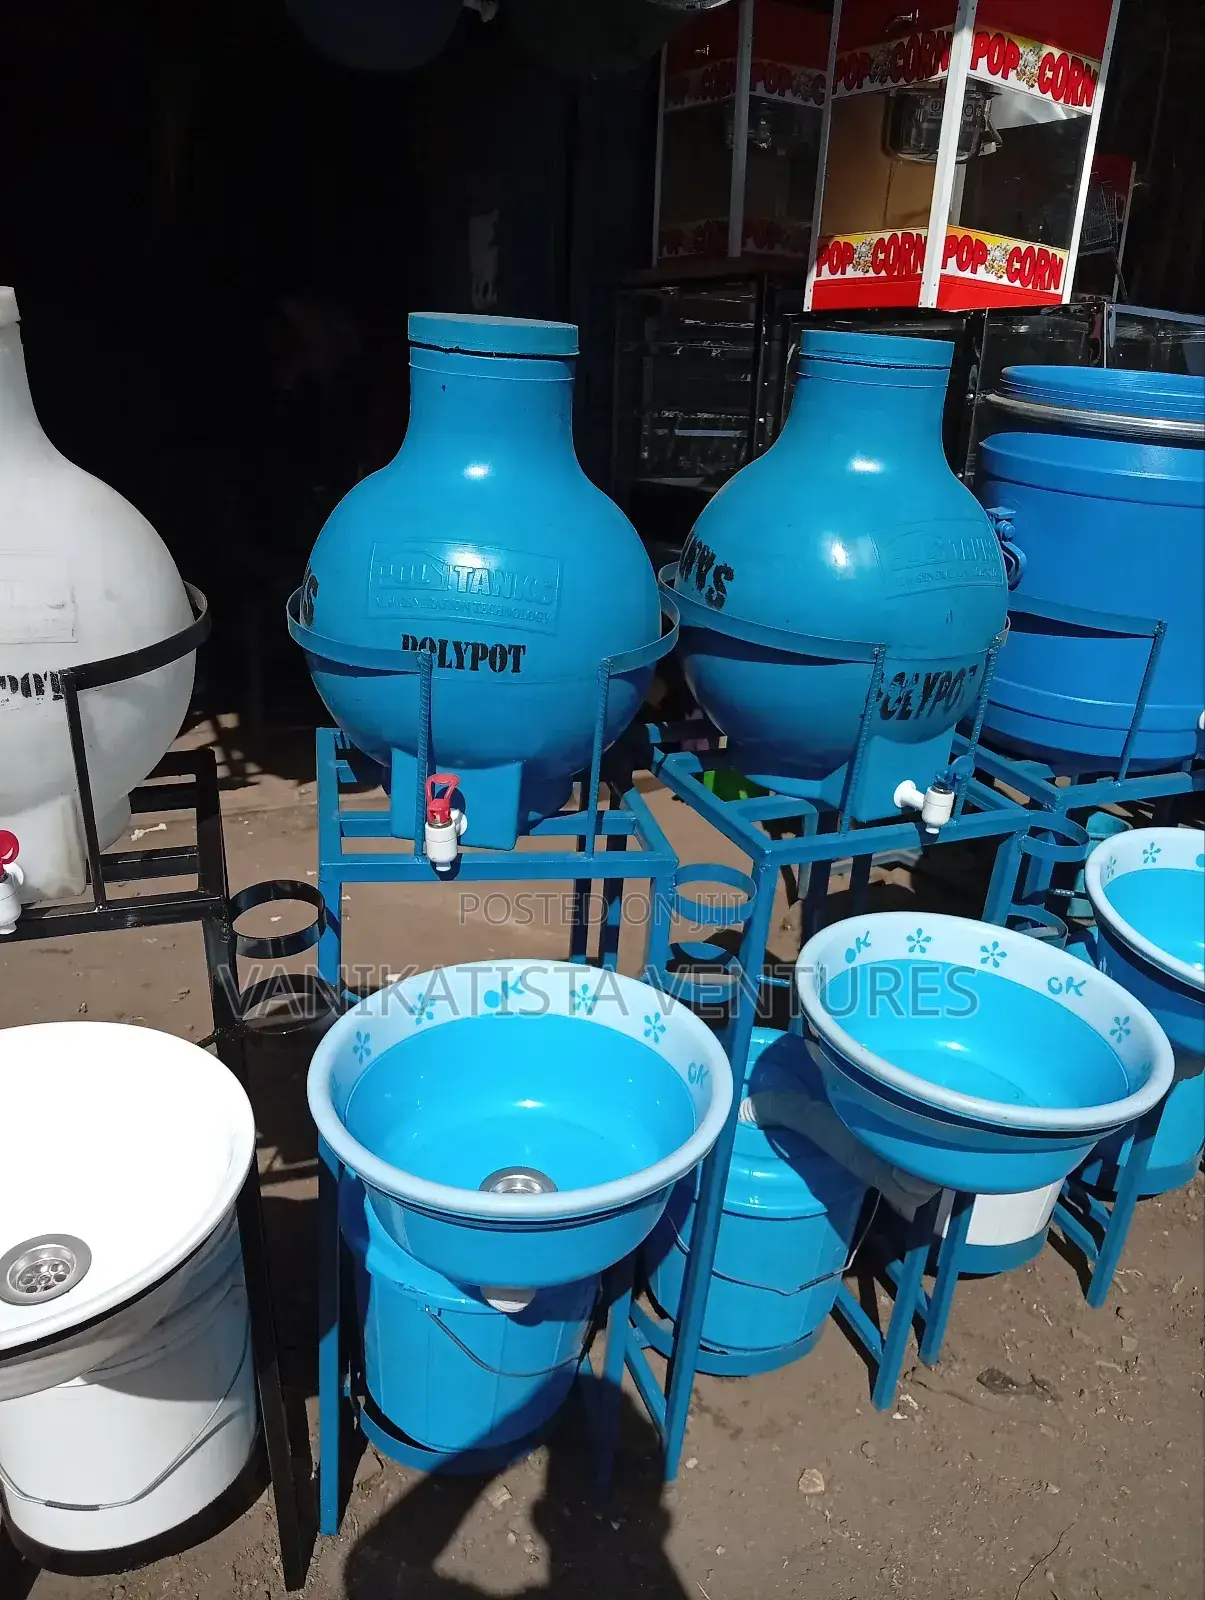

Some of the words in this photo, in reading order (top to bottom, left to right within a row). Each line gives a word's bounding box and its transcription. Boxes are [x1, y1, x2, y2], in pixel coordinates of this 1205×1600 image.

[890, 30, 954, 84] CORN
[970, 32, 1020, 80] POP
[1038, 52, 1099, 107] CORN
[816, 241, 854, 277] POP
[872, 232, 927, 276] CORN
[941, 235, 988, 274] POP
[1006, 246, 1064, 290] CORN
[1047, 976, 1087, 997] OK
[687, 1061, 709, 1088] OK
